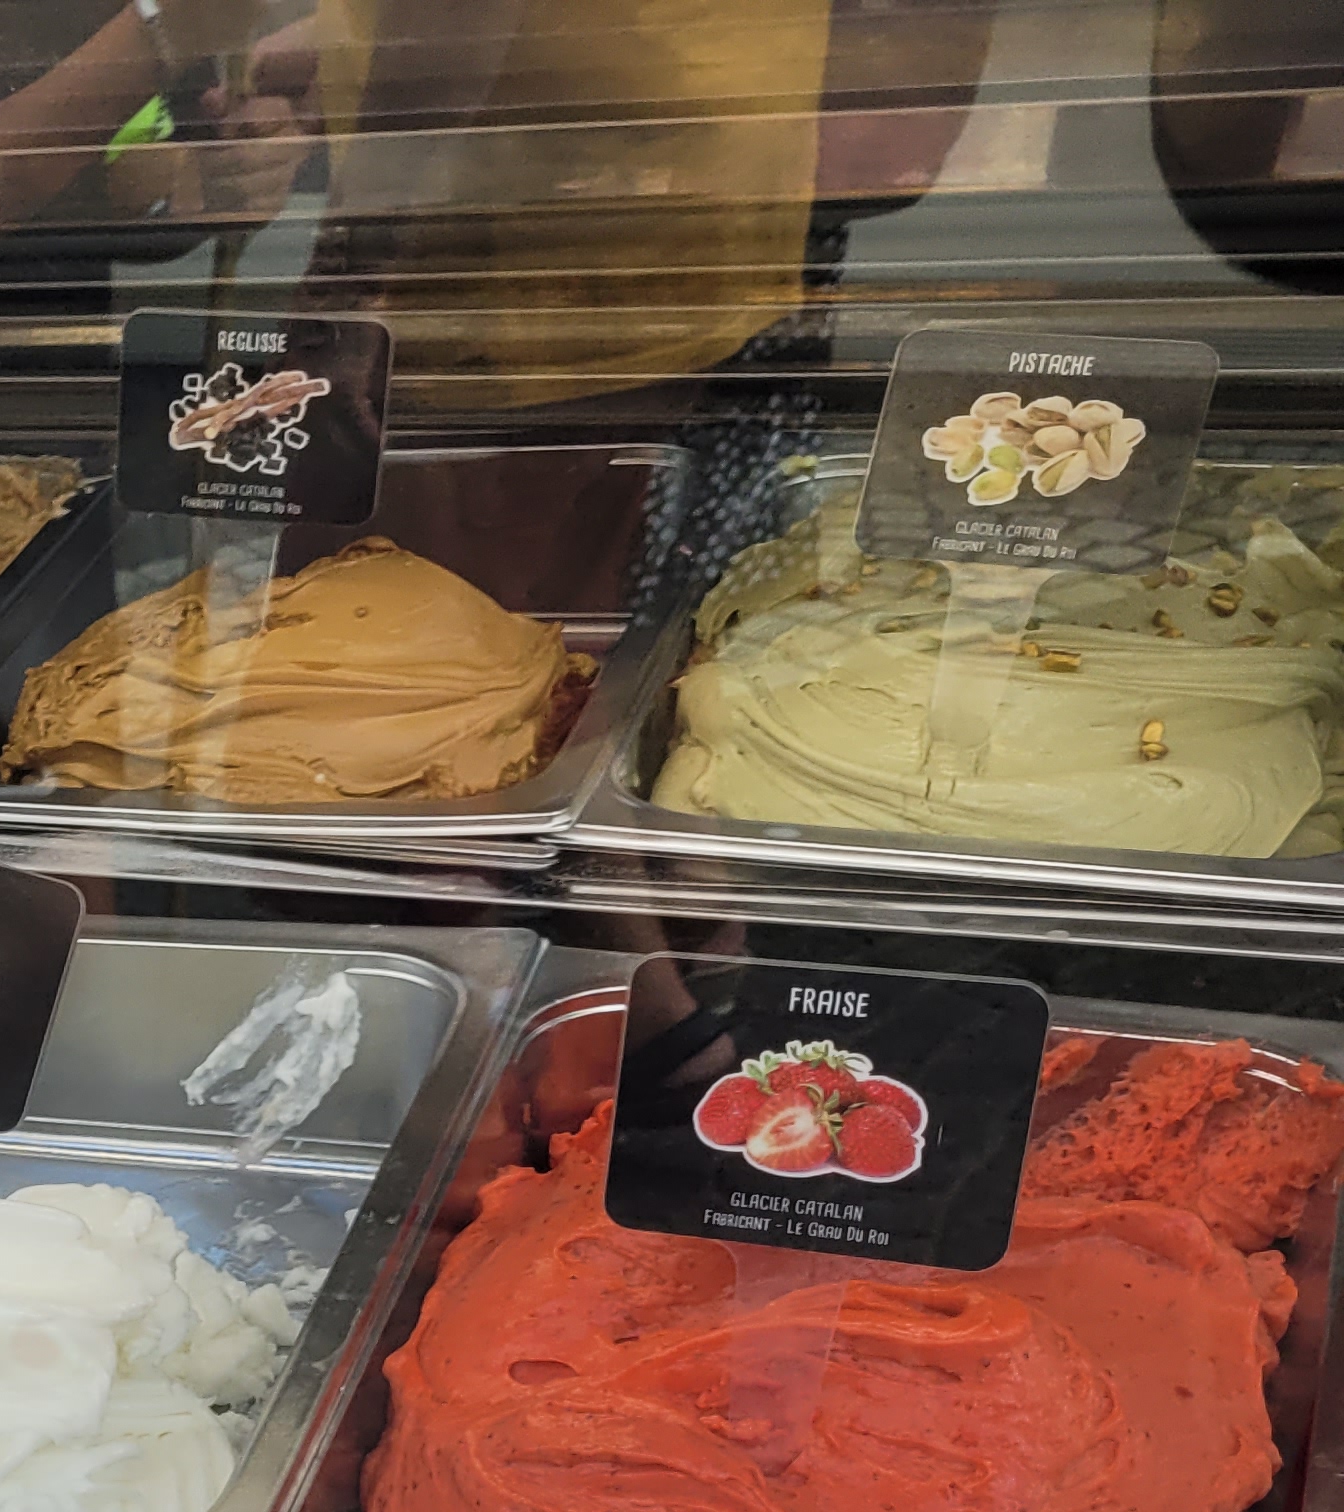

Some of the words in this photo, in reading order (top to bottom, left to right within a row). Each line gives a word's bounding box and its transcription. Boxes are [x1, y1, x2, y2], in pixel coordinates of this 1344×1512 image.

[1008, 351, 1096, 377] PISTACHE
[788, 986, 871, 1018] FRAISE
[730, 1191, 791, 1213] GLACIER
[794, 1199, 864, 1222] CATALAN
